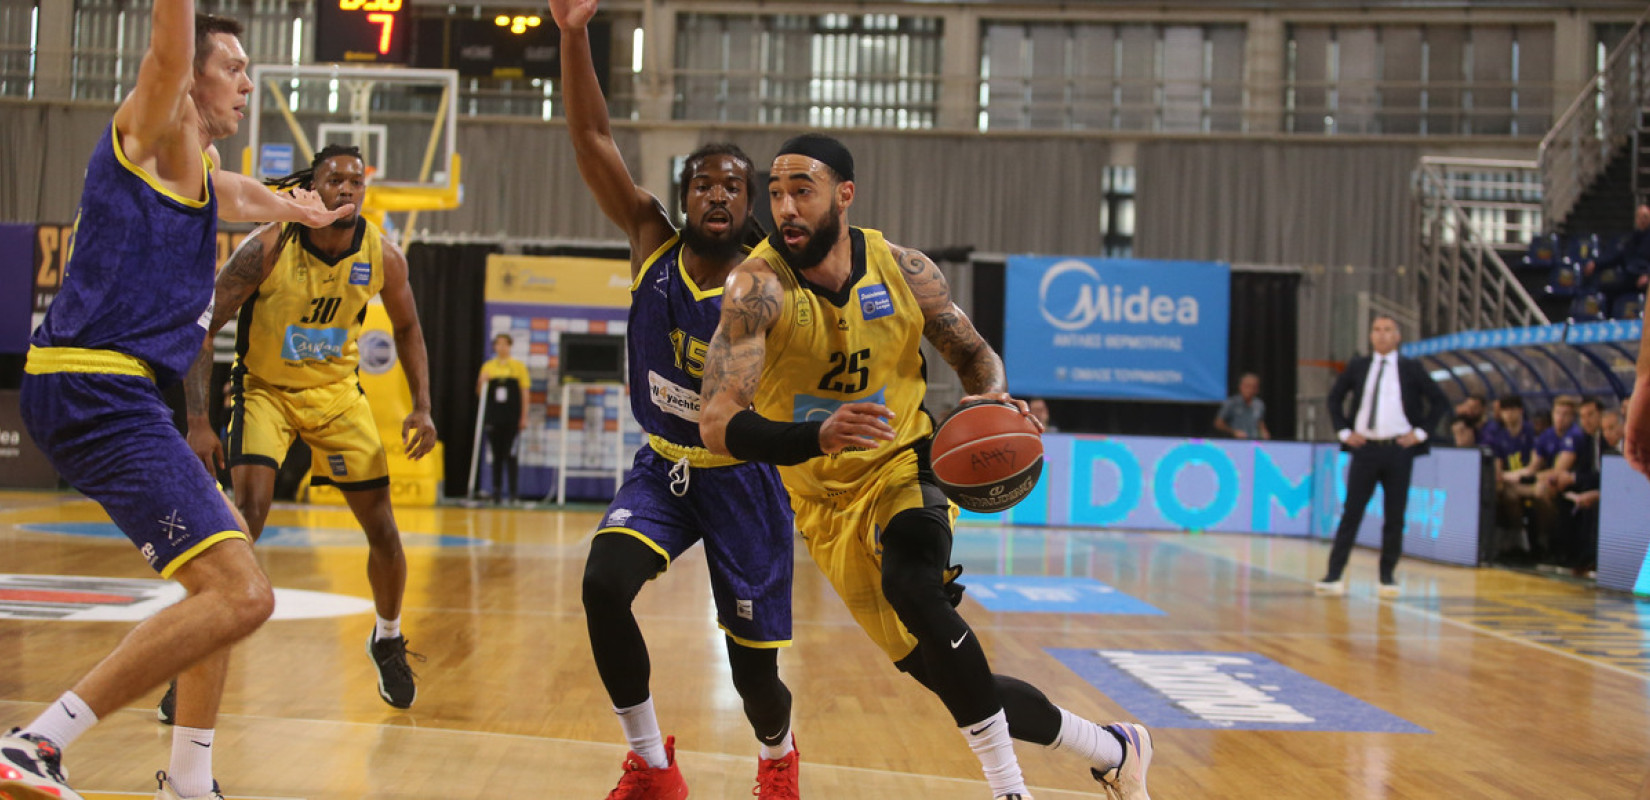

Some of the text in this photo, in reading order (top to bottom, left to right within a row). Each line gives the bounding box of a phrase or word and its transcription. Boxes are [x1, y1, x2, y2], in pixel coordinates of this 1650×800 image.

[367, 12, 395, 54] 7
[300, 296, 342, 323] 30
[668, 330, 709, 379] 15
[817, 349, 870, 393] 25
[959, 475, 1033, 507] SPALDING
